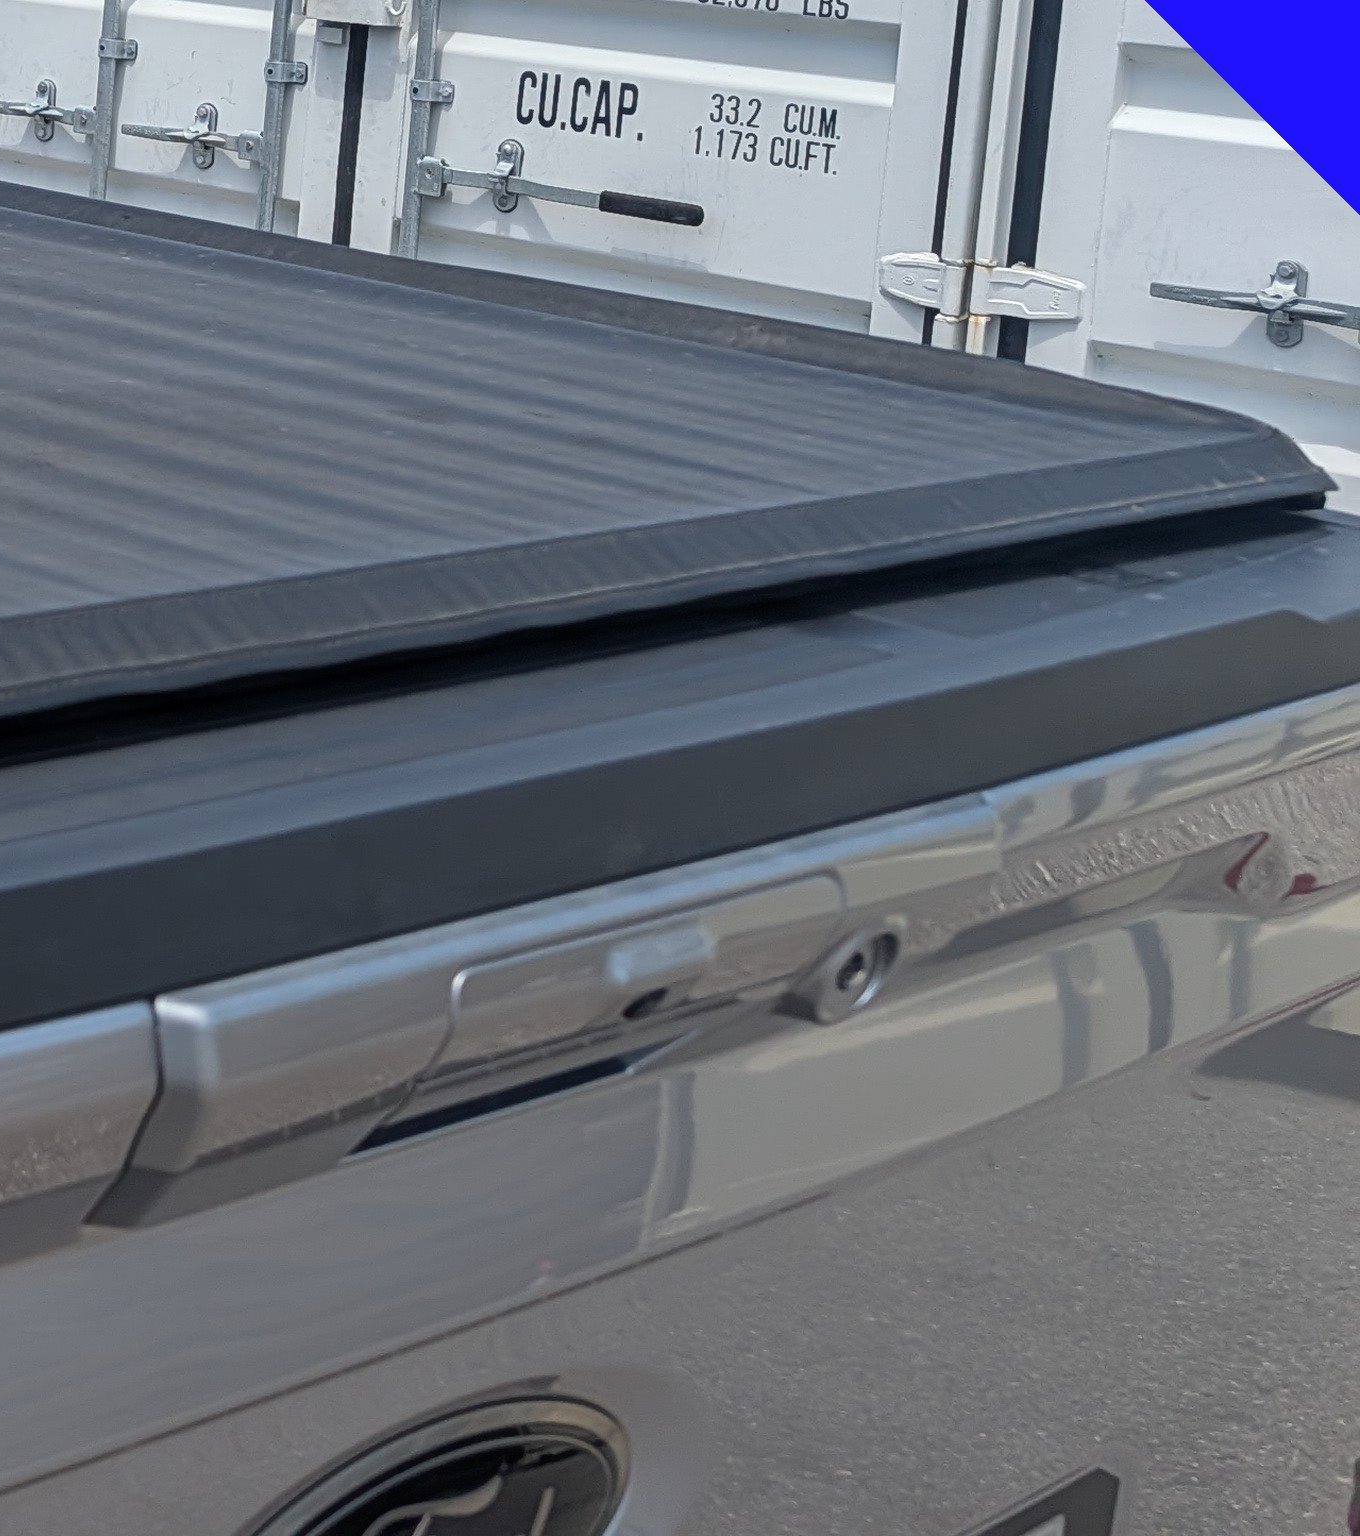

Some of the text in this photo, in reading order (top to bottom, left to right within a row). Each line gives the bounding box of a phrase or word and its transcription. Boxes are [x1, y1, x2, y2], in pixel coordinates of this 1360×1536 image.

[709, 93, 762, 128] 33.2
[783, 103, 841, 140] CU.M.
[769, 136, 837, 175] CU.FT.
